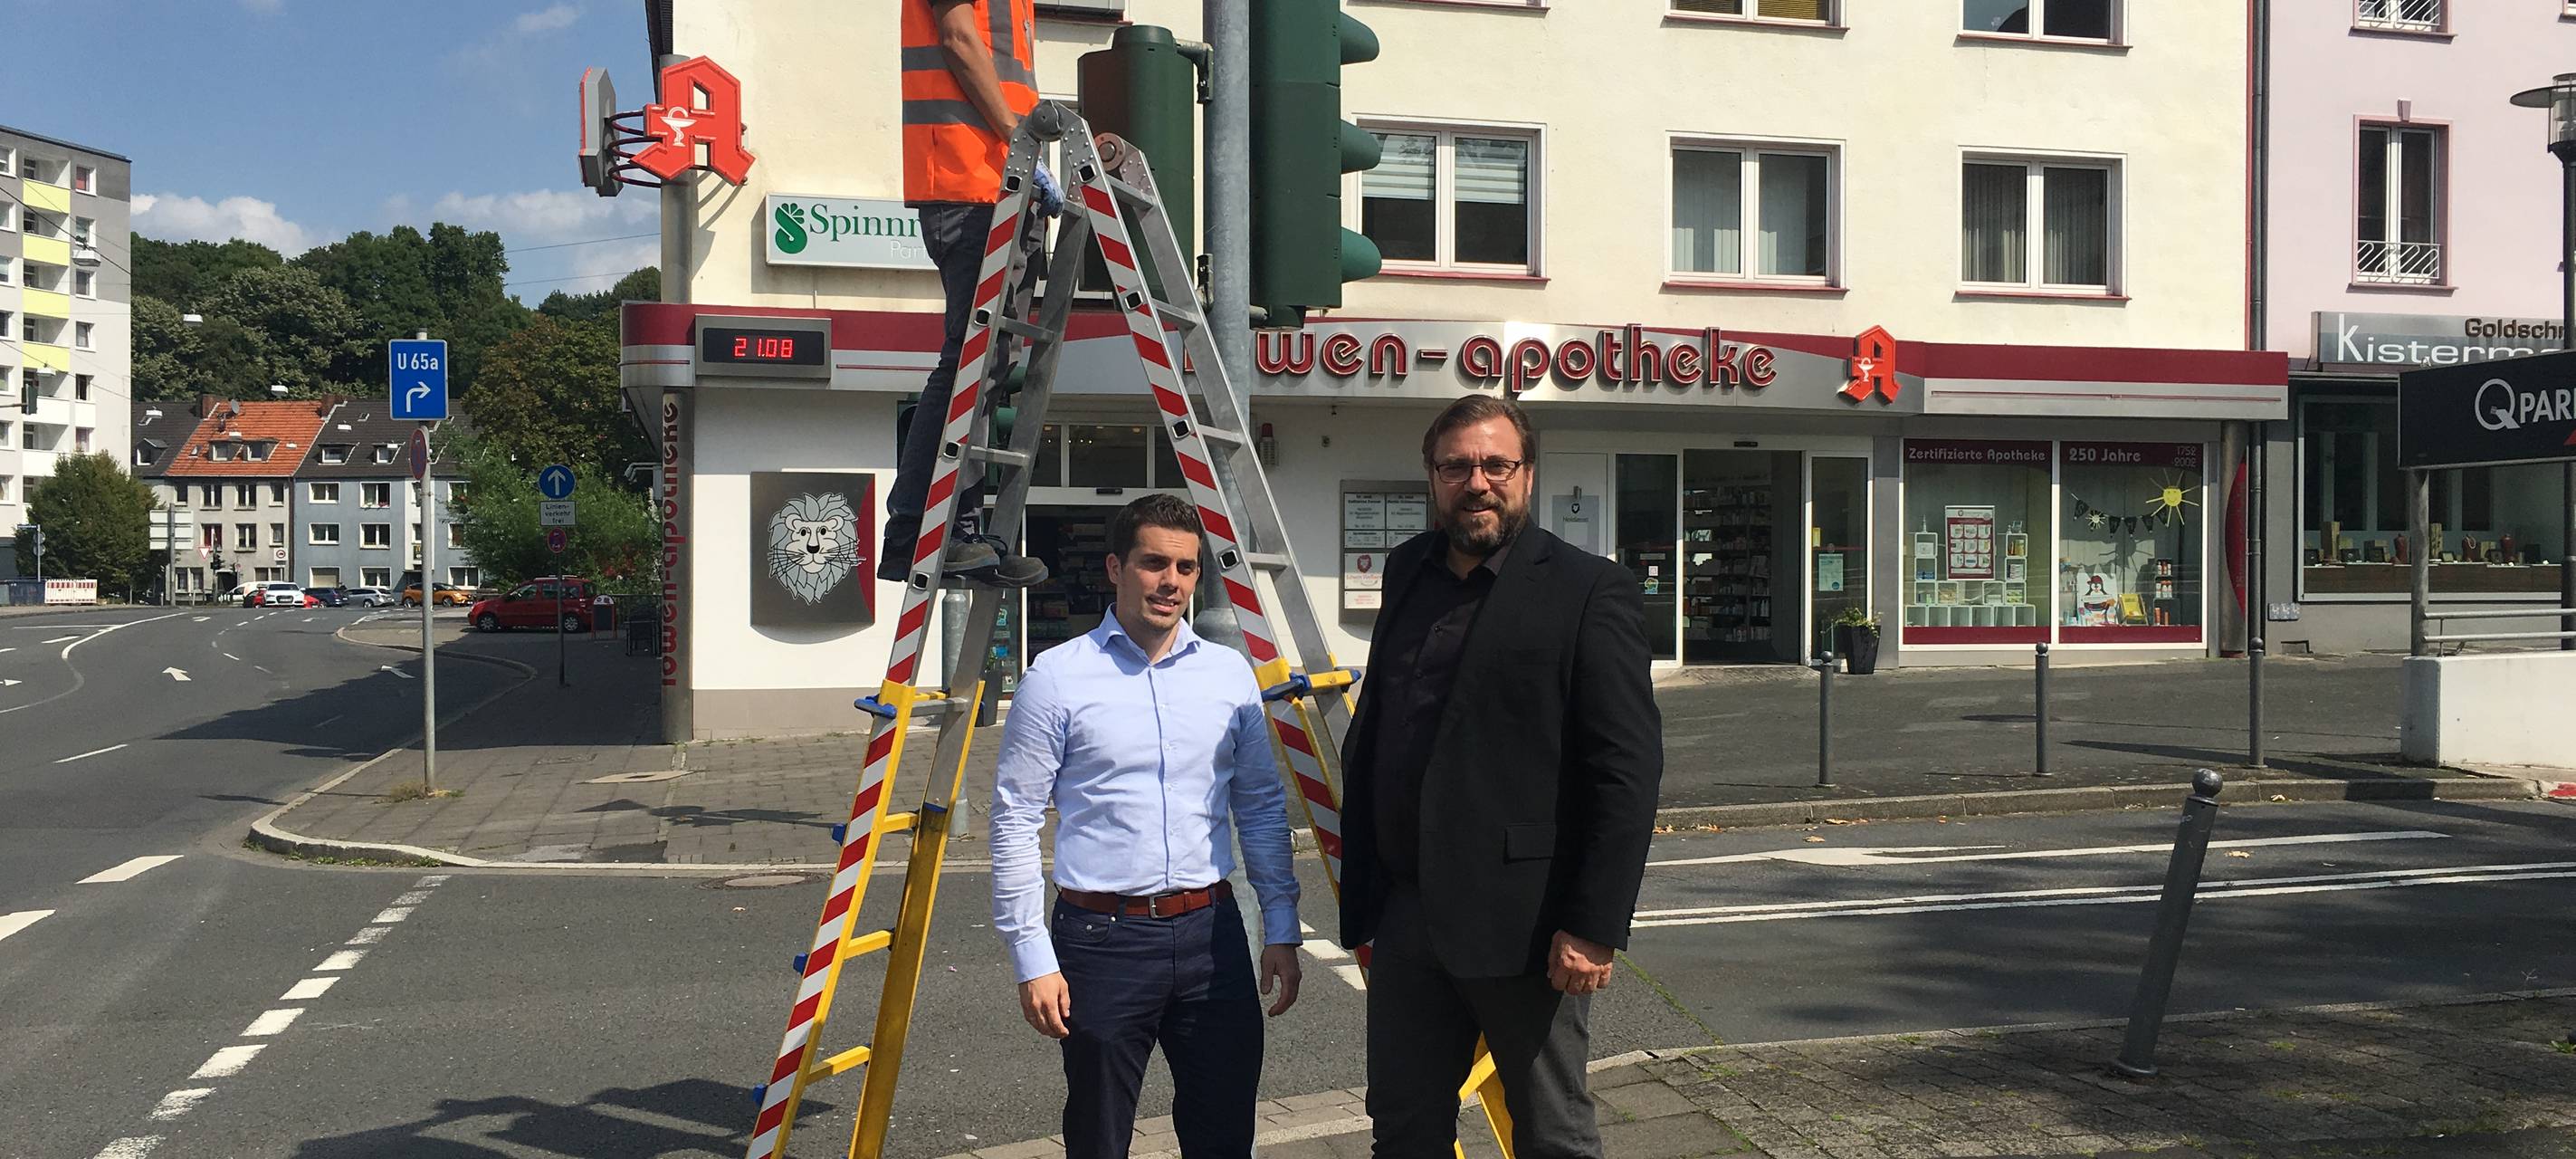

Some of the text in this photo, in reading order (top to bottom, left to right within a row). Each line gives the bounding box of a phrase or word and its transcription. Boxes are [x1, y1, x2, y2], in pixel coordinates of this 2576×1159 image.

[2337, 312, 2563, 363] Kisterm
[733, 337, 794, 359] 21.08
[1184, 323, 1777, 392] wen-apotheke
[397, 352, 439, 370] U 65a
[2474, 378, 2576, 431] QPAR
[1908, 447, 2046, 464] Zertifizierte Apotheke
[2068, 447, 2142, 463] 250 Jahre
[2177, 445, 2197, 456] 1752
